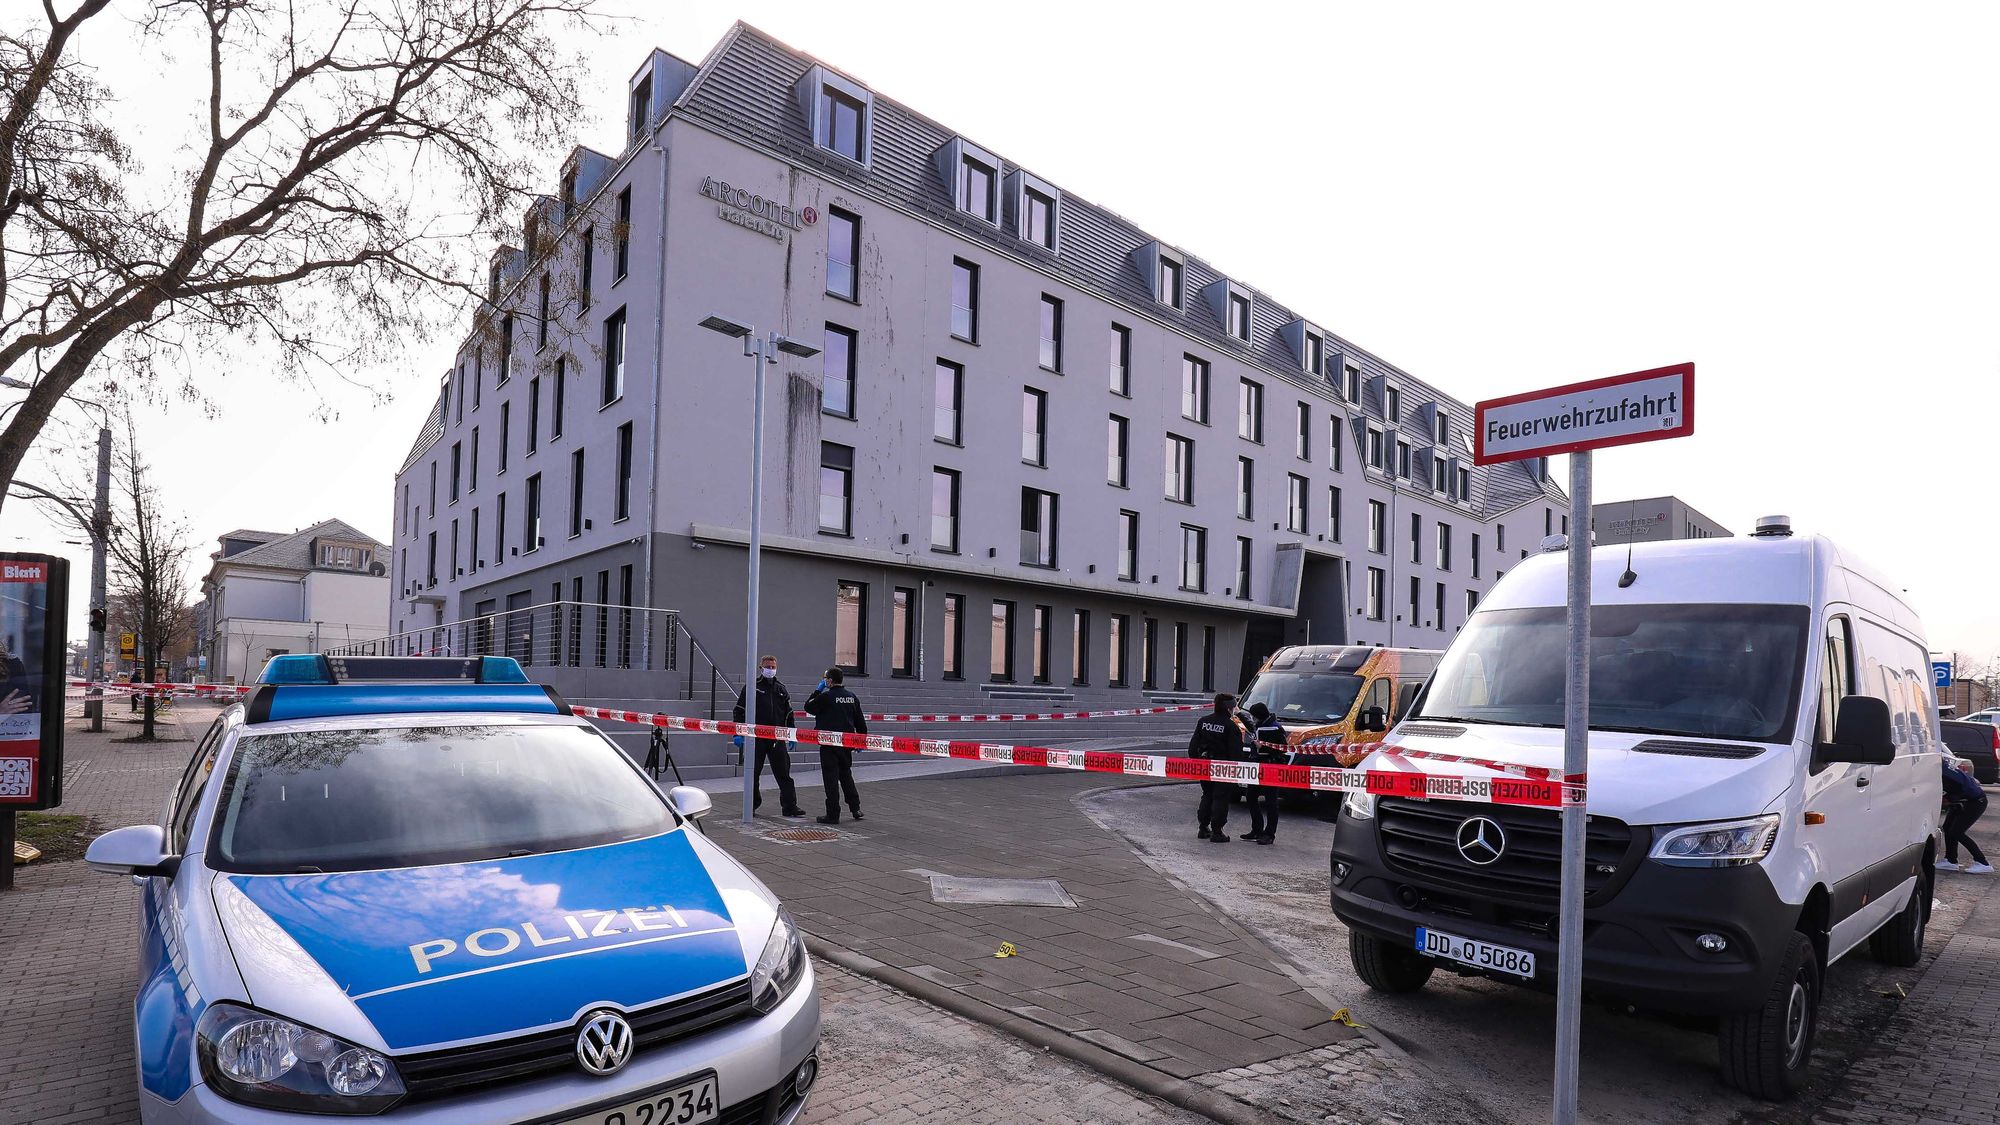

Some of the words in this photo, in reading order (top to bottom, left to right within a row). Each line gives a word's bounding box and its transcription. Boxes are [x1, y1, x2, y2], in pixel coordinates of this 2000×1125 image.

[698, 175, 804, 231] ARCOTEL
[1487, 391, 1677, 442] Feuerwehrzufahrt
[4, 566, 41, 578] Blatt
[1935, 670, 1947, 683] P
[1202, 722, 1225, 733] POLIZEI
[985, 747, 1058, 764] POLIZEIABSPERRUNG
[1068, 753, 1153, 772] POLIZEIABSPERRUNG
[0, 771, 30, 783] EN
[1166, 761, 1265, 780] POLIZEIABSPERRUNG
[1277, 768, 1394, 789] POLIZEIABSPERRUNG
[1409, 777, 1551, 800] POLIZEIABSPERRUNG
[408, 904, 689, 974] POLIZEI
[999, 944, 1011, 955] 50
[1426, 932, 1451, 954] DD
[1463, 942, 1476, 961] Q
[1480, 945, 1532, 973] 5086
[635, 1083, 713, 1125] 2234
